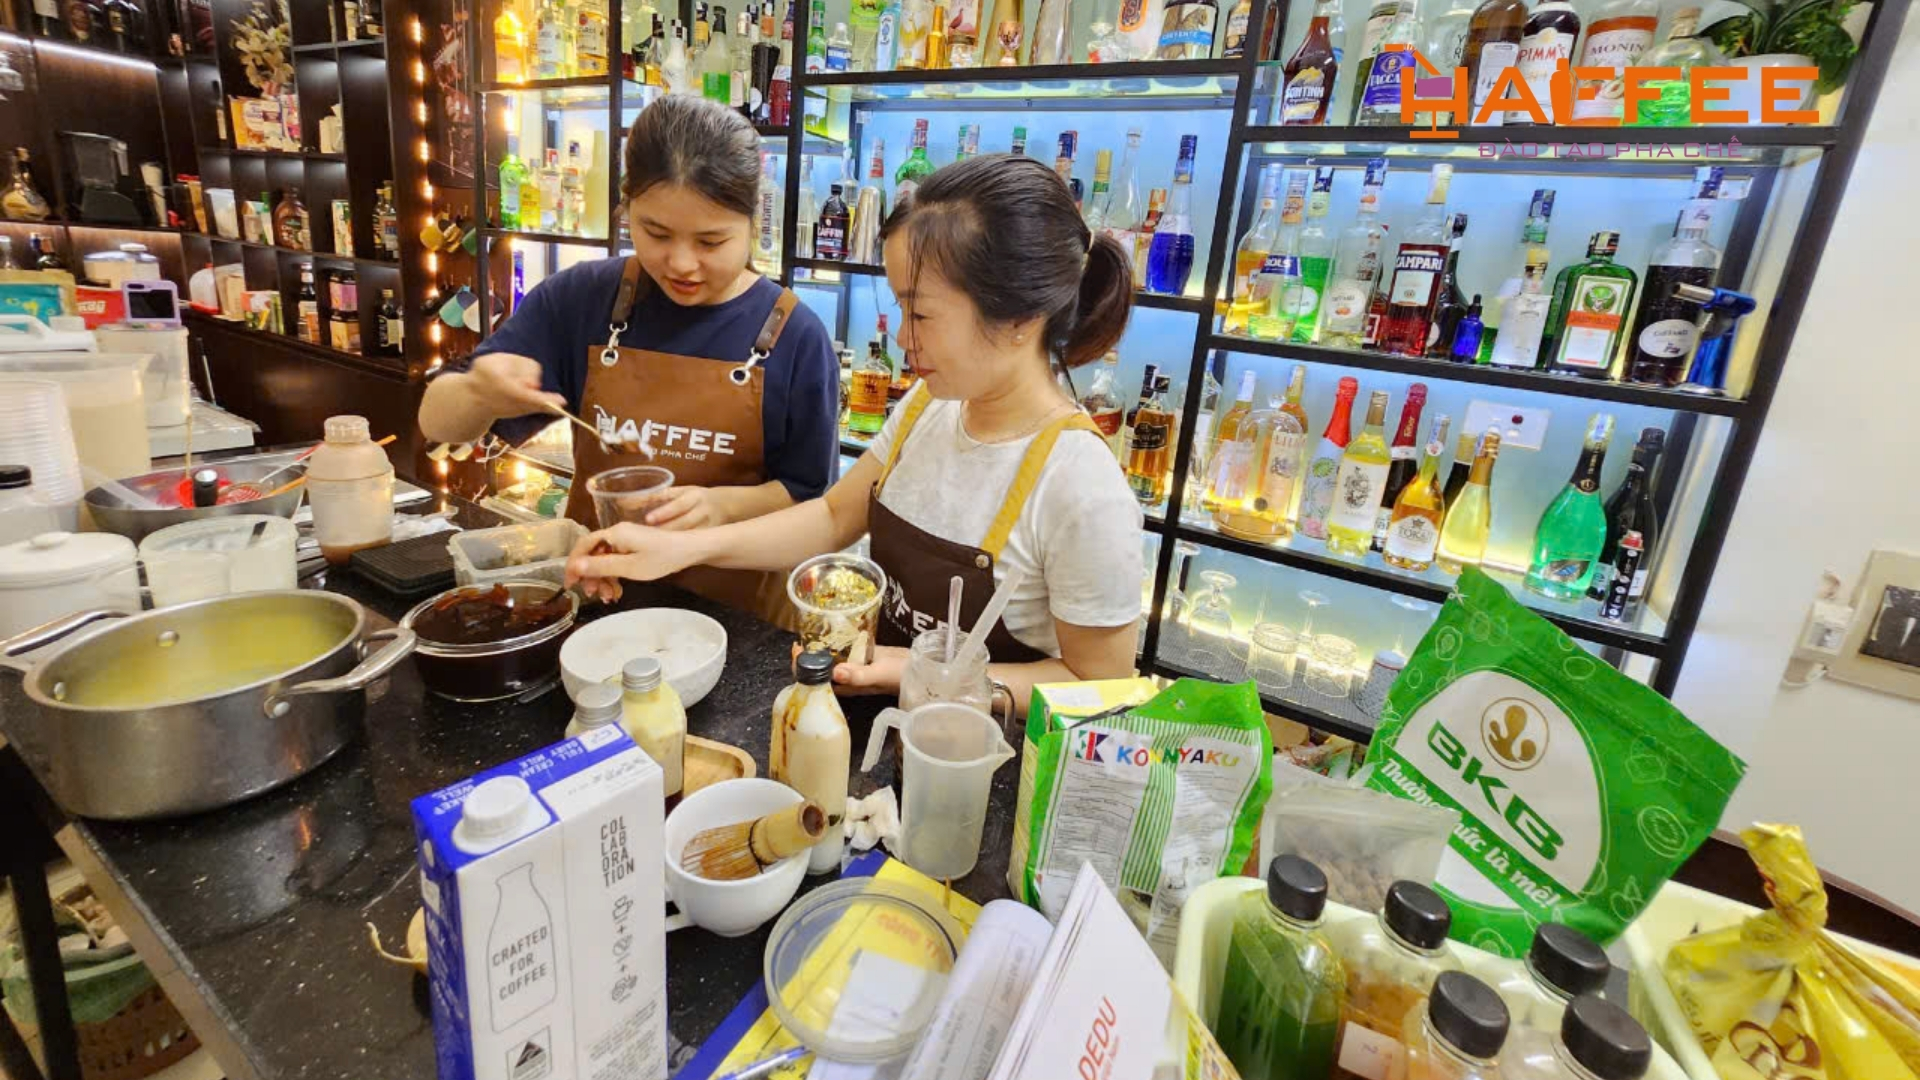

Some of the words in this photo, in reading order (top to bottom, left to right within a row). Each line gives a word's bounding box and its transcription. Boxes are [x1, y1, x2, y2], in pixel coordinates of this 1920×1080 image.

[1396, 255, 1444, 271] CAMPARI
[1116, 745, 1241, 768] KONNYAKU
[1426, 719, 1565, 861] BKB
[600, 815, 626, 841] COL
[600, 830, 627, 857] LAB
[602, 846, 629, 872] ORA
[603, 857, 635, 888] TION
[491, 925, 548, 967] CRAFTED
[509, 951, 535, 977] FOR
[499, 962, 548, 1002] COFFEE
